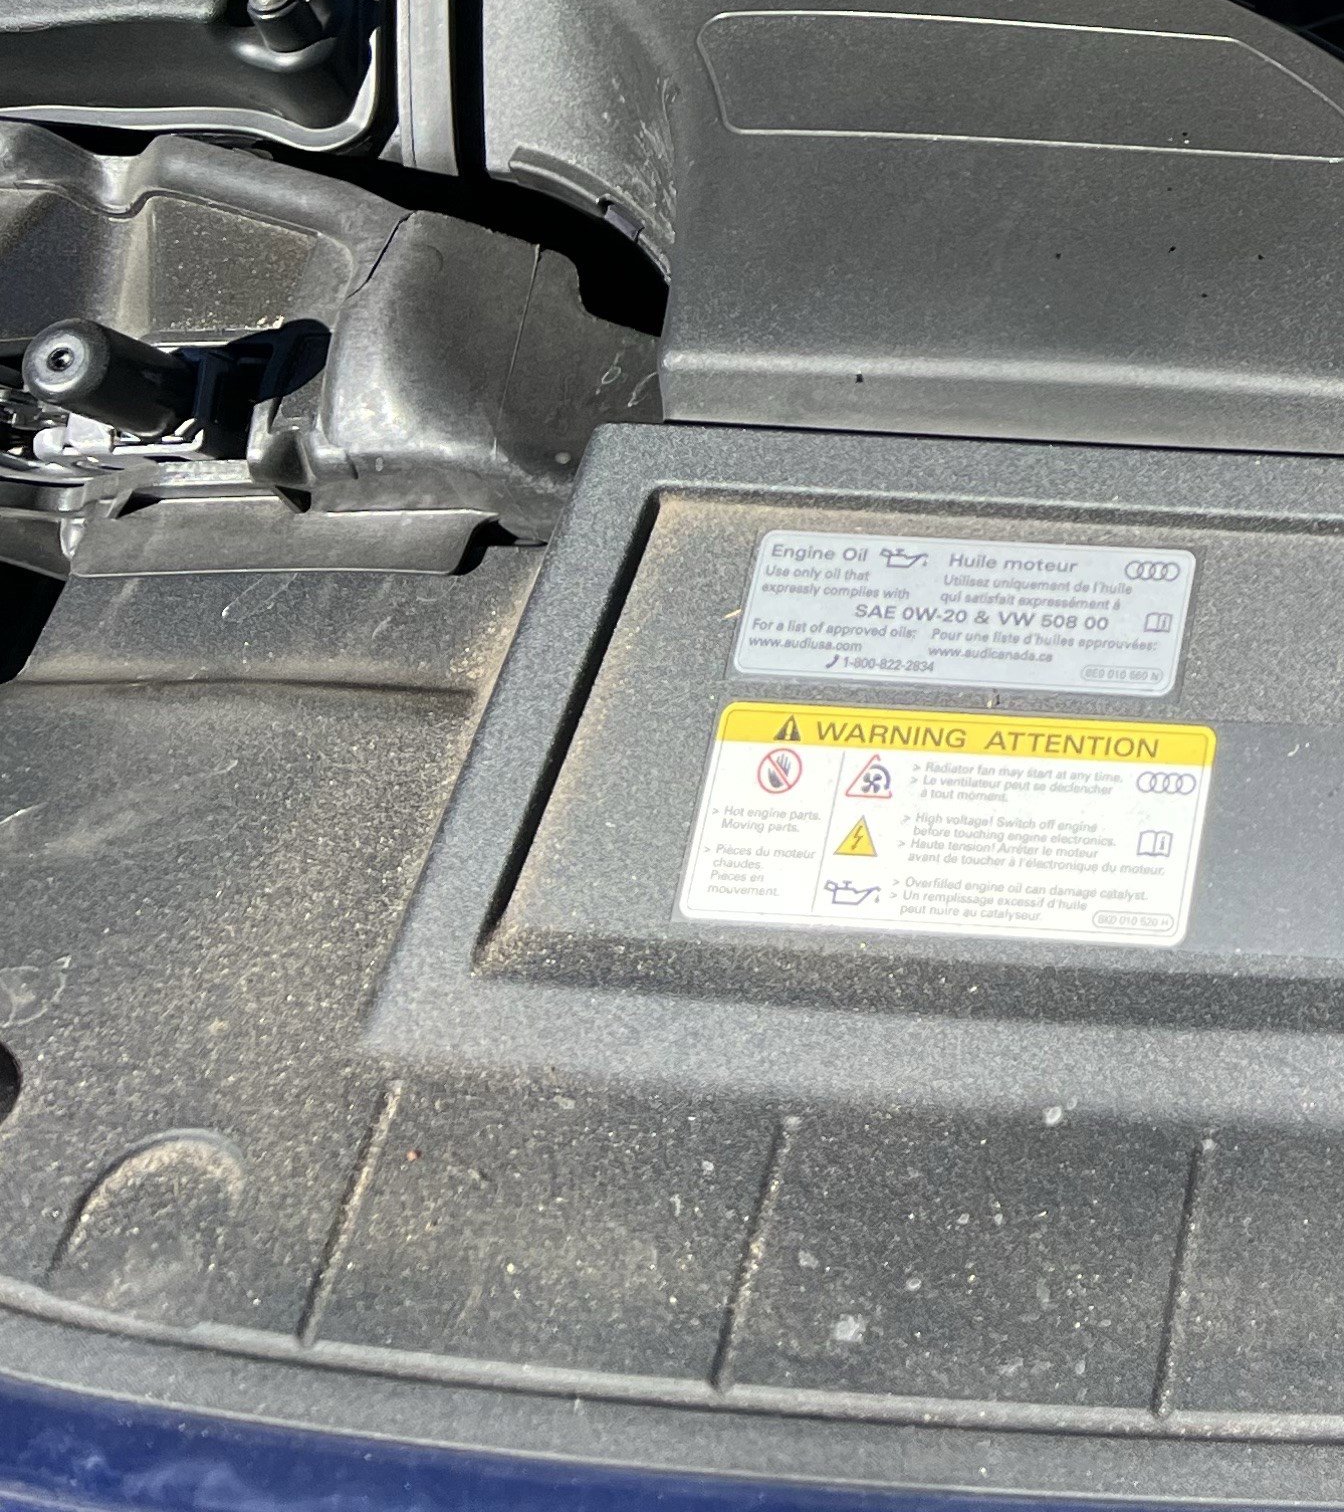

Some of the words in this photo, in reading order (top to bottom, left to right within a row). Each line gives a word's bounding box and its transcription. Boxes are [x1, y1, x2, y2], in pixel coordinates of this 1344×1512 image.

[771, 544, 835, 562] Engine
[842, 547, 869, 562] Oil
[765, 564, 790, 578] Use
[793, 566, 821, 580] only
[824, 568, 841, 579] oil
[844, 569, 870, 581] that
[949, 553, 997, 570] Huile
[1003, 556, 1078, 573] moteur
[762, 582, 820, 597] expressly
[823, 584, 880, 599] complies
[883, 588, 910, 600] with
[944, 574, 990, 588] Utilisez
[992, 576, 1070, 593] uniquement
[1073, 580, 1090, 592] de
[1093, 580, 1132, 595] l'huile
[940, 591, 961, 605] qui
[965, 592, 1015, 606] satisfait
[1018, 594, 1110, 611] expressément
[855, 604, 897, 619] SAE
[902, 606, 967, 623] 0W-20
[974, 610, 990, 624] &
[998, 611, 1035, 627] VW
[1041, 614, 1078, 629] 508
[1084, 615, 1109, 630] 00
[752, 618, 774, 631] For
[776, 622, 784, 632] a
[787, 619, 806, 632] list
[809, 621, 824, 633] of
[826, 624, 887, 638] approved
[932, 628, 962, 642] Pour
[966, 632, 989, 643] une
[993, 631, 1020, 644] liste
[1024, 633, 1074, 647] d'huiles
[749, 637, 863, 653] www.audiusa.com
[928, 646, 1054, 662] www.audicanada.ca
[816, 721, 968, 749] WARNING
[985, 730, 1160, 758] ATTENTION
[925, 761, 975, 775] Radiator
[977, 764, 996, 776] fan
[998, 768, 1025, 779] may
[1027, 767, 1053, 779] start
[1056, 770, 1067, 780] at
[1070, 772, 1092, 783] any
[923, 775, 937, 786] Le
[940, 777, 1002, 789] ventilateur
[1003, 780, 1031, 792] peut
[1033, 782, 1047, 791] se
[930, 789, 954, 800] tout
[723, 805, 745, 816] Hot
[747, 808, 787, 820] engine
[789, 810, 821, 821] parts.
[721, 818, 765, 834] Moving
[767, 822, 800, 834] parts.
[915, 812, 943, 826] High
[946, 815, 994, 829] voltage!
[996, 816, 1036, 830] Switch
[1038, 819, 1056, 830] off
[1057, 821, 1098, 834] engine
[913, 825, 951, 838] before
[953, 828, 1005, 842] touching
[1006, 831, 1048, 844] engine
[1050, 833, 1117, 847] electronics.
[755, 846, 770, 857] du
[773, 848, 816, 859] moteur
[911, 838, 945, 850] Haute
[948, 840, 996, 852] tension!
[1042, 846, 1053, 856] le
[1055, 847, 1099, 858] moteur
[907, 852, 941, 863] avant
[943, 852, 958, 864] de
[960, 854, 1006, 866] toucher
[1101, 861, 1117, 873] du
[750, 874, 764, 882] en
[902, 889, 920, 901] Un
[922, 892, 994, 907] remplissage
[996, 895, 1045, 908] excessif
[905, 876, 963, 890] Overfilled
[964, 879, 1005, 894] engine
[1007, 882, 1023, 894] oil
[1025, 885, 1046, 895] can
[1049, 884, 1097, 900] damage
[1099, 888, 1149, 902] catalyst.
[899, 904, 926, 916] peut
[929, 905, 960, 917] nuire
[962, 908, 978, 918] au
